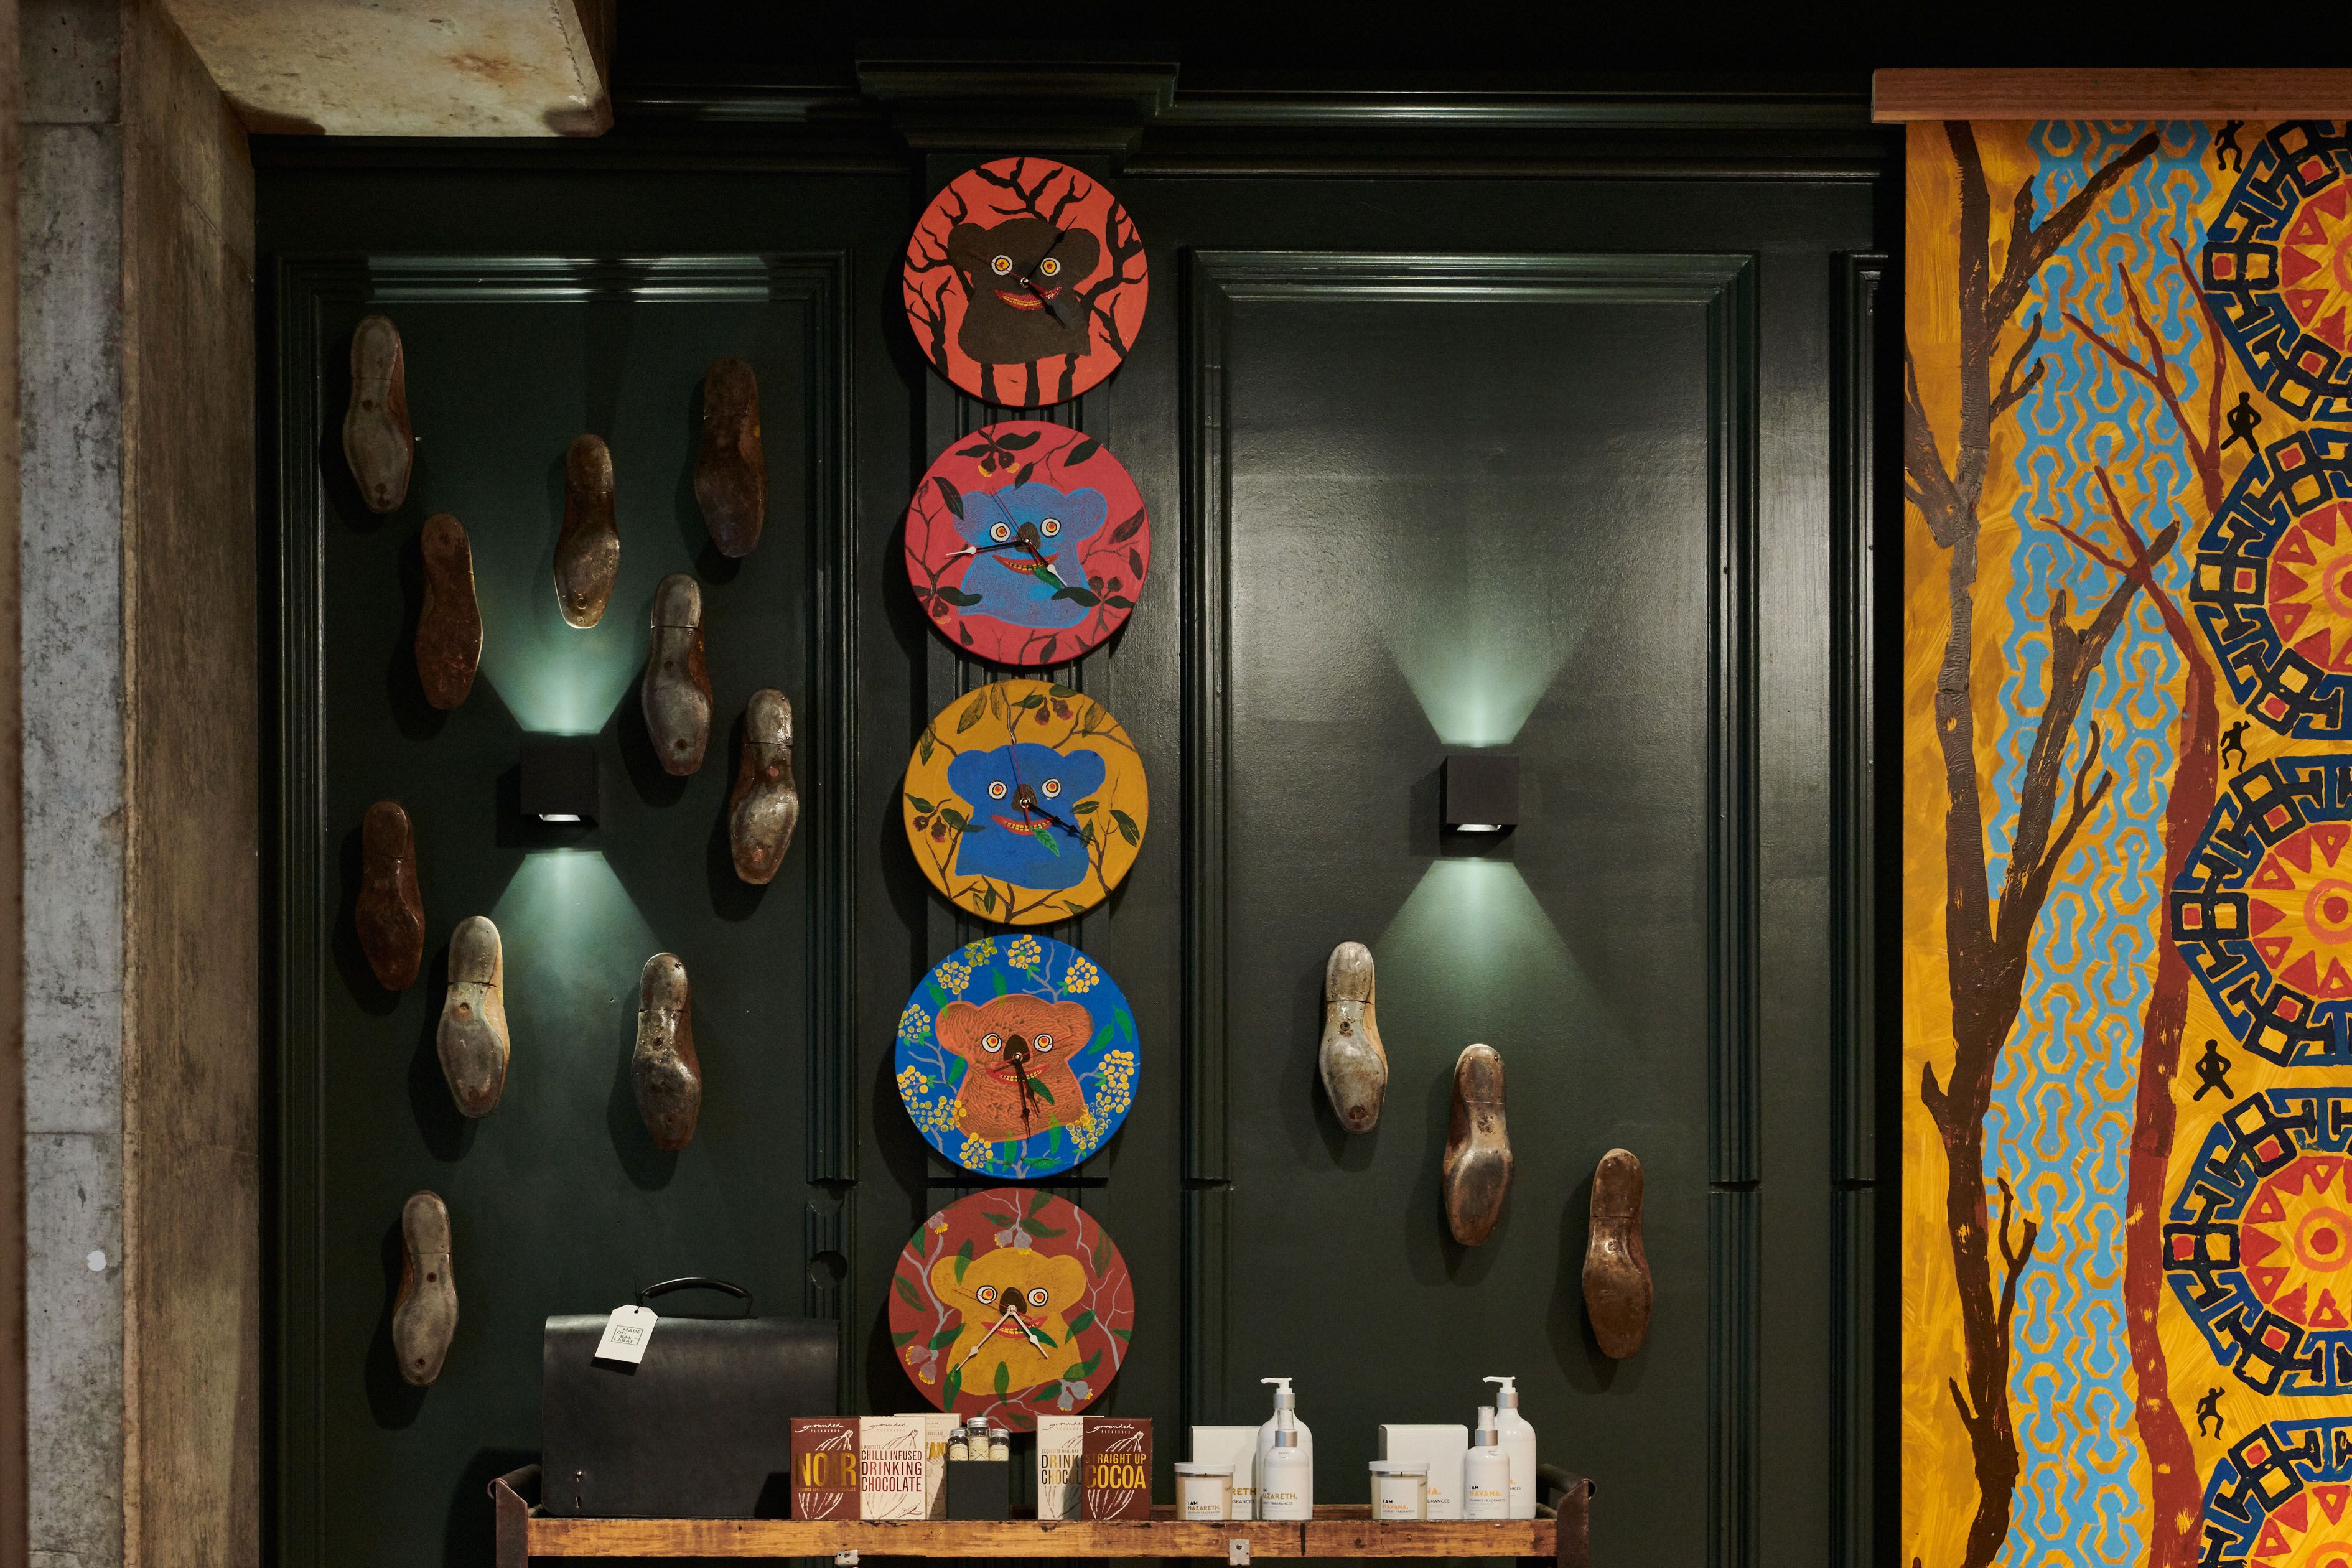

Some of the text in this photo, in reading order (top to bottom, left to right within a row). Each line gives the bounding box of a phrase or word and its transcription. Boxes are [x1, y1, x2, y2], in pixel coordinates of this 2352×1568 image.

[795, 1422, 844, 1432] grounded
[862, 1422, 910, 1431] grounded
[1042, 1422, 1083, 1430] grounde
[1086, 1424, 1134, 1434] grounded
[862, 1450, 922, 1460] CHILLI INFUSED
[1085, 1453, 1147, 1464] STRAIGHT UP
[1042, 1455, 1082, 1468] DRINK
[796, 1452, 856, 1486] NOIR
[862, 1462, 922, 1475] DRINKING
[1085, 1465, 1146, 1488] COCOA
[862, 1477, 922, 1491] CHOCOLATE
